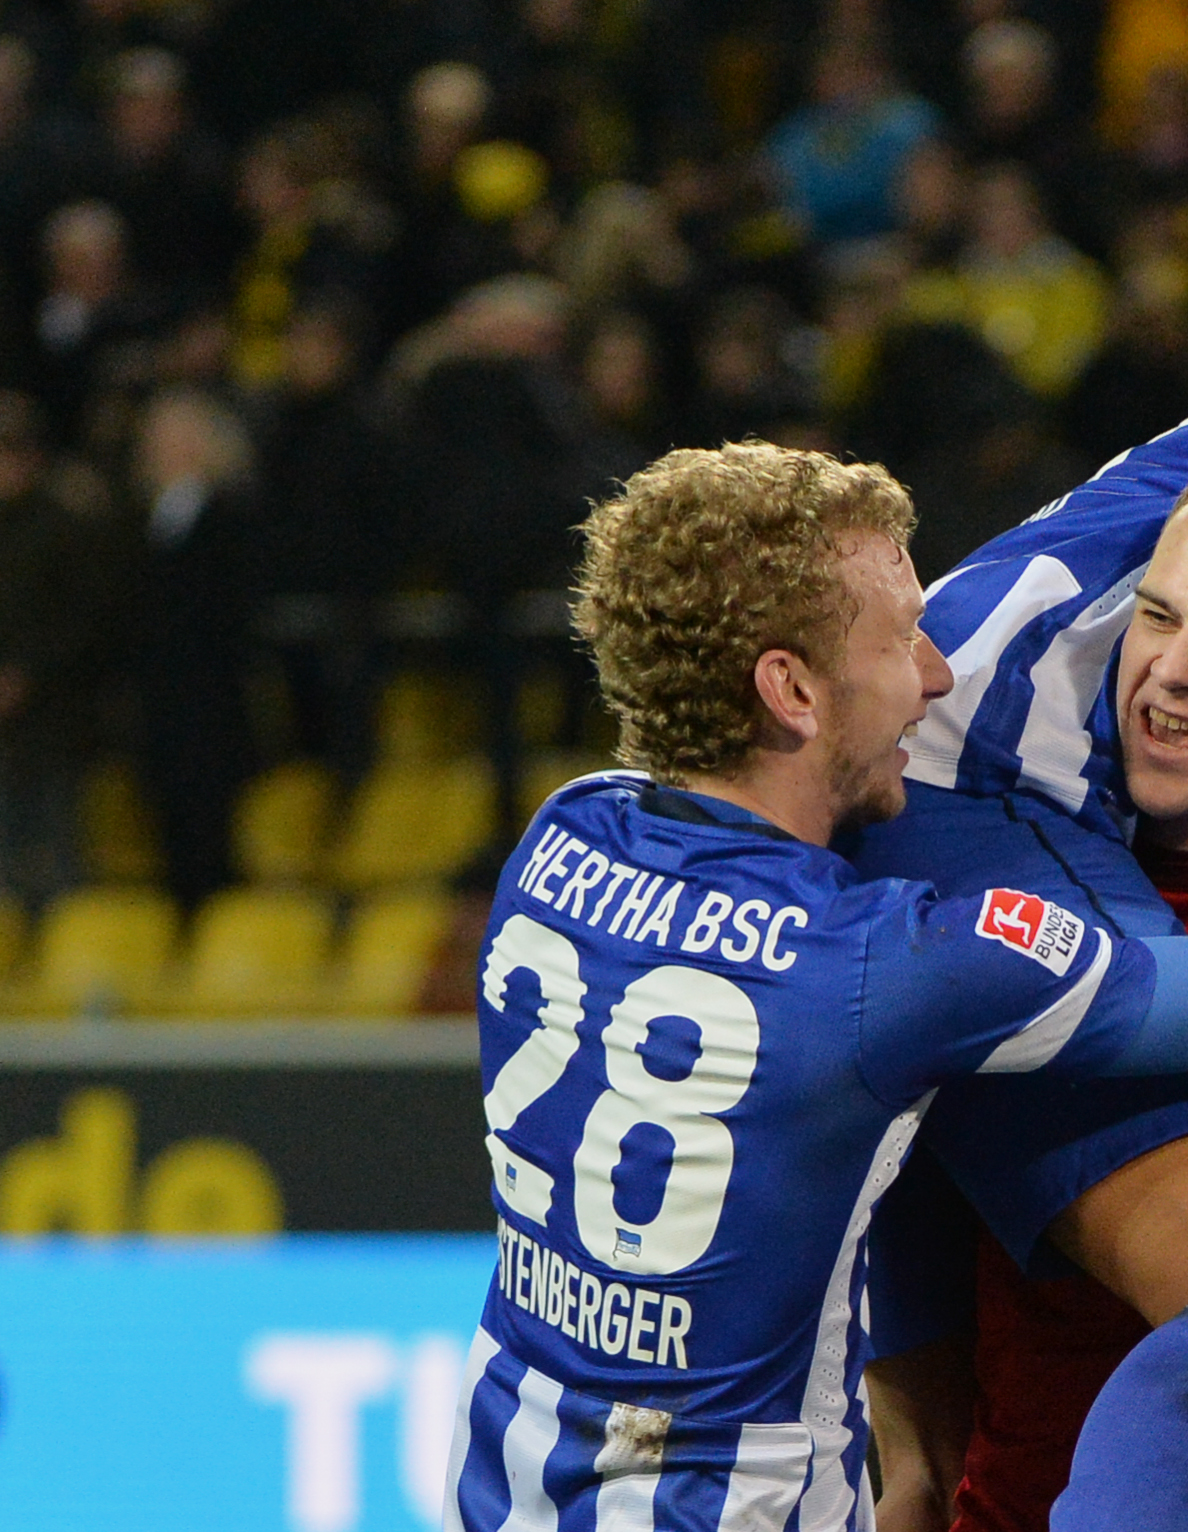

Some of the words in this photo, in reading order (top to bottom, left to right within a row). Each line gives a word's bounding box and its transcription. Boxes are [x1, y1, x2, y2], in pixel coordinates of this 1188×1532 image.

[518, 823, 686, 947] HERTHA
[680, 890, 809, 972] BSC
[1055, 919, 1079, 958] LIGA
[482, 913, 761, 1276] 28
